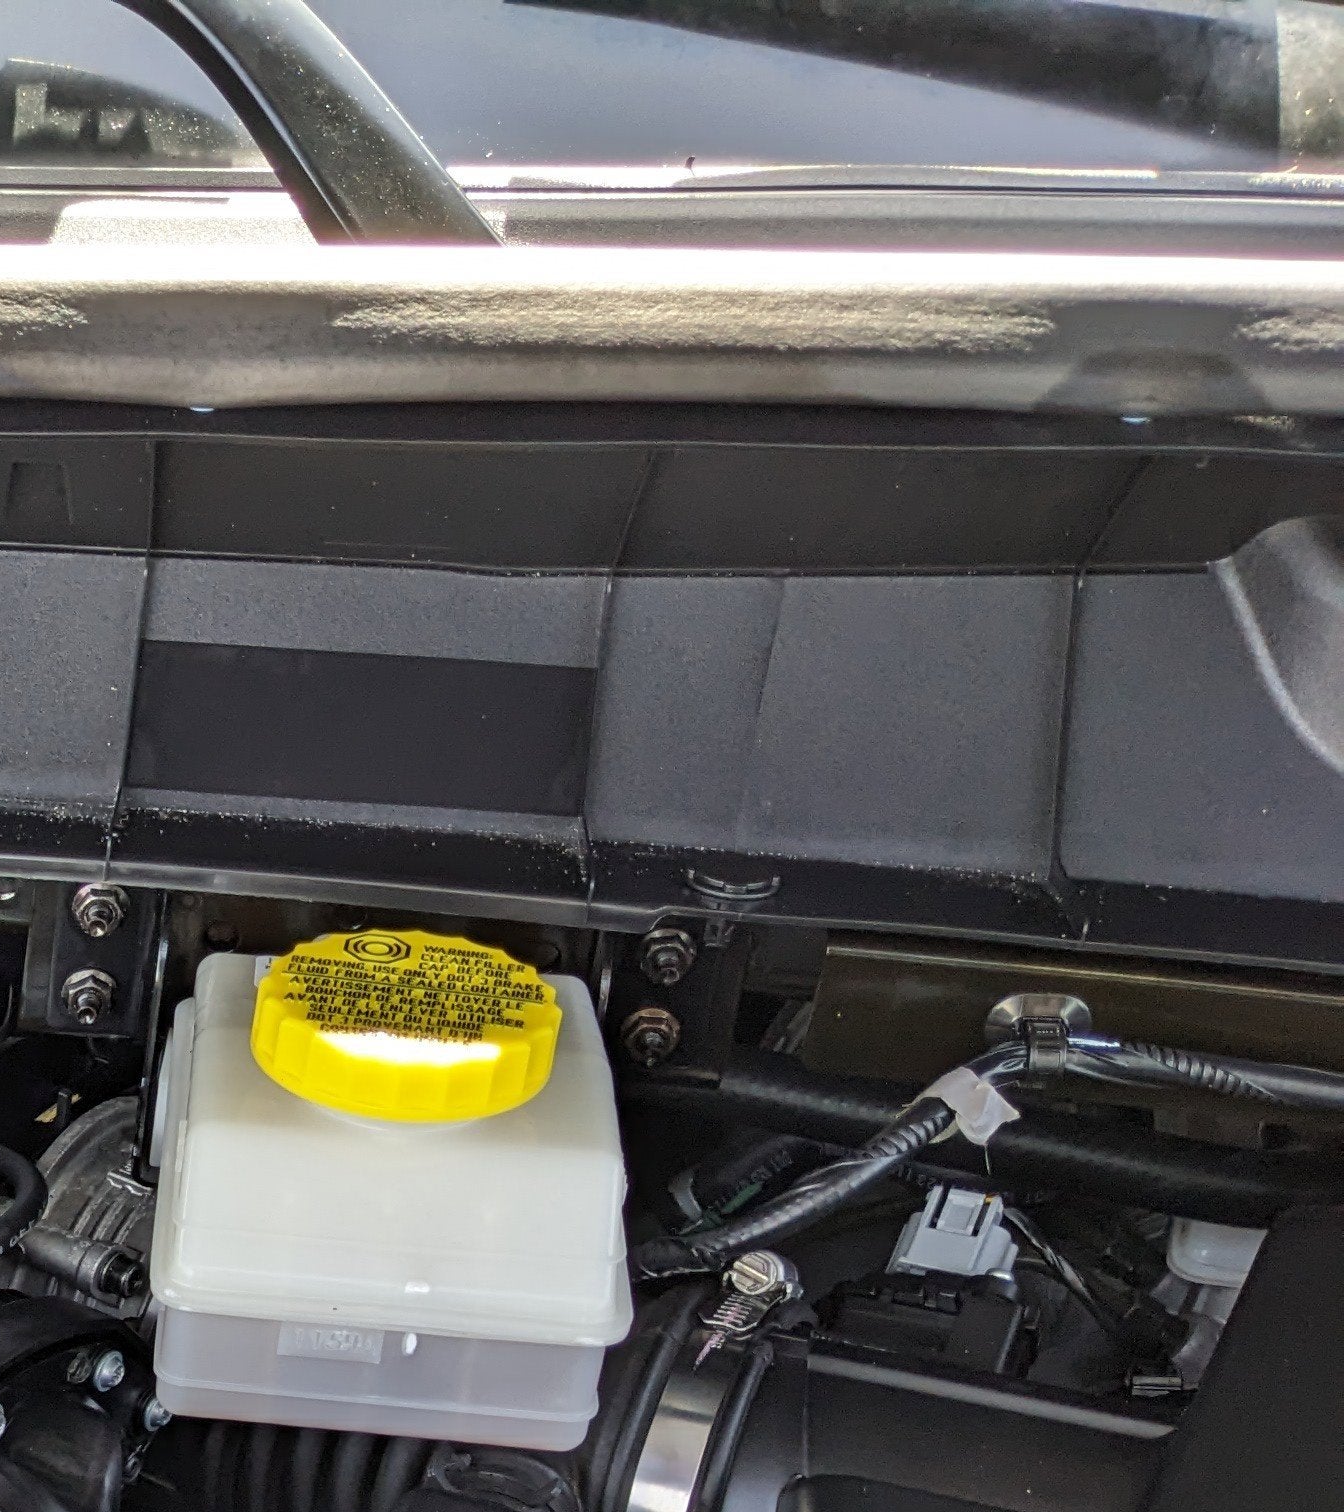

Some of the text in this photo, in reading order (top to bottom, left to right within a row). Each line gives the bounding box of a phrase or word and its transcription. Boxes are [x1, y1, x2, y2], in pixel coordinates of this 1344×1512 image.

[288, 962, 329, 974] FLUID
[334, 968, 375, 980] FROM
[398, 976, 456, 989] SEALED
[418, 962, 510, 979] CAP BEFORE
[421, 953, 525, 973] CLEAN FILLER
[373, 964, 397, 975] USE
[404, 968, 440, 980] ONLY
[447, 973, 473, 984] DOT
[480, 977, 488, 986] 3
[493, 979, 544, 992] BRAKE
[284, 992, 335, 1004] AVANT
[342, 998, 358, 1007] DE
[457, 1012, 524, 1029] UTILISER
[305, 985, 504, 1017] BOUCHON DE REMPLISSAGE
[423, 991, 501, 1007] NETTOYER
[506, 1000, 523, 1011] LE
[306, 1012, 334, 1022] DOT
[340, 1016, 349, 1024] 3
[310, 1003, 483, 1031] SEULEMENT DU LIQUIDE
